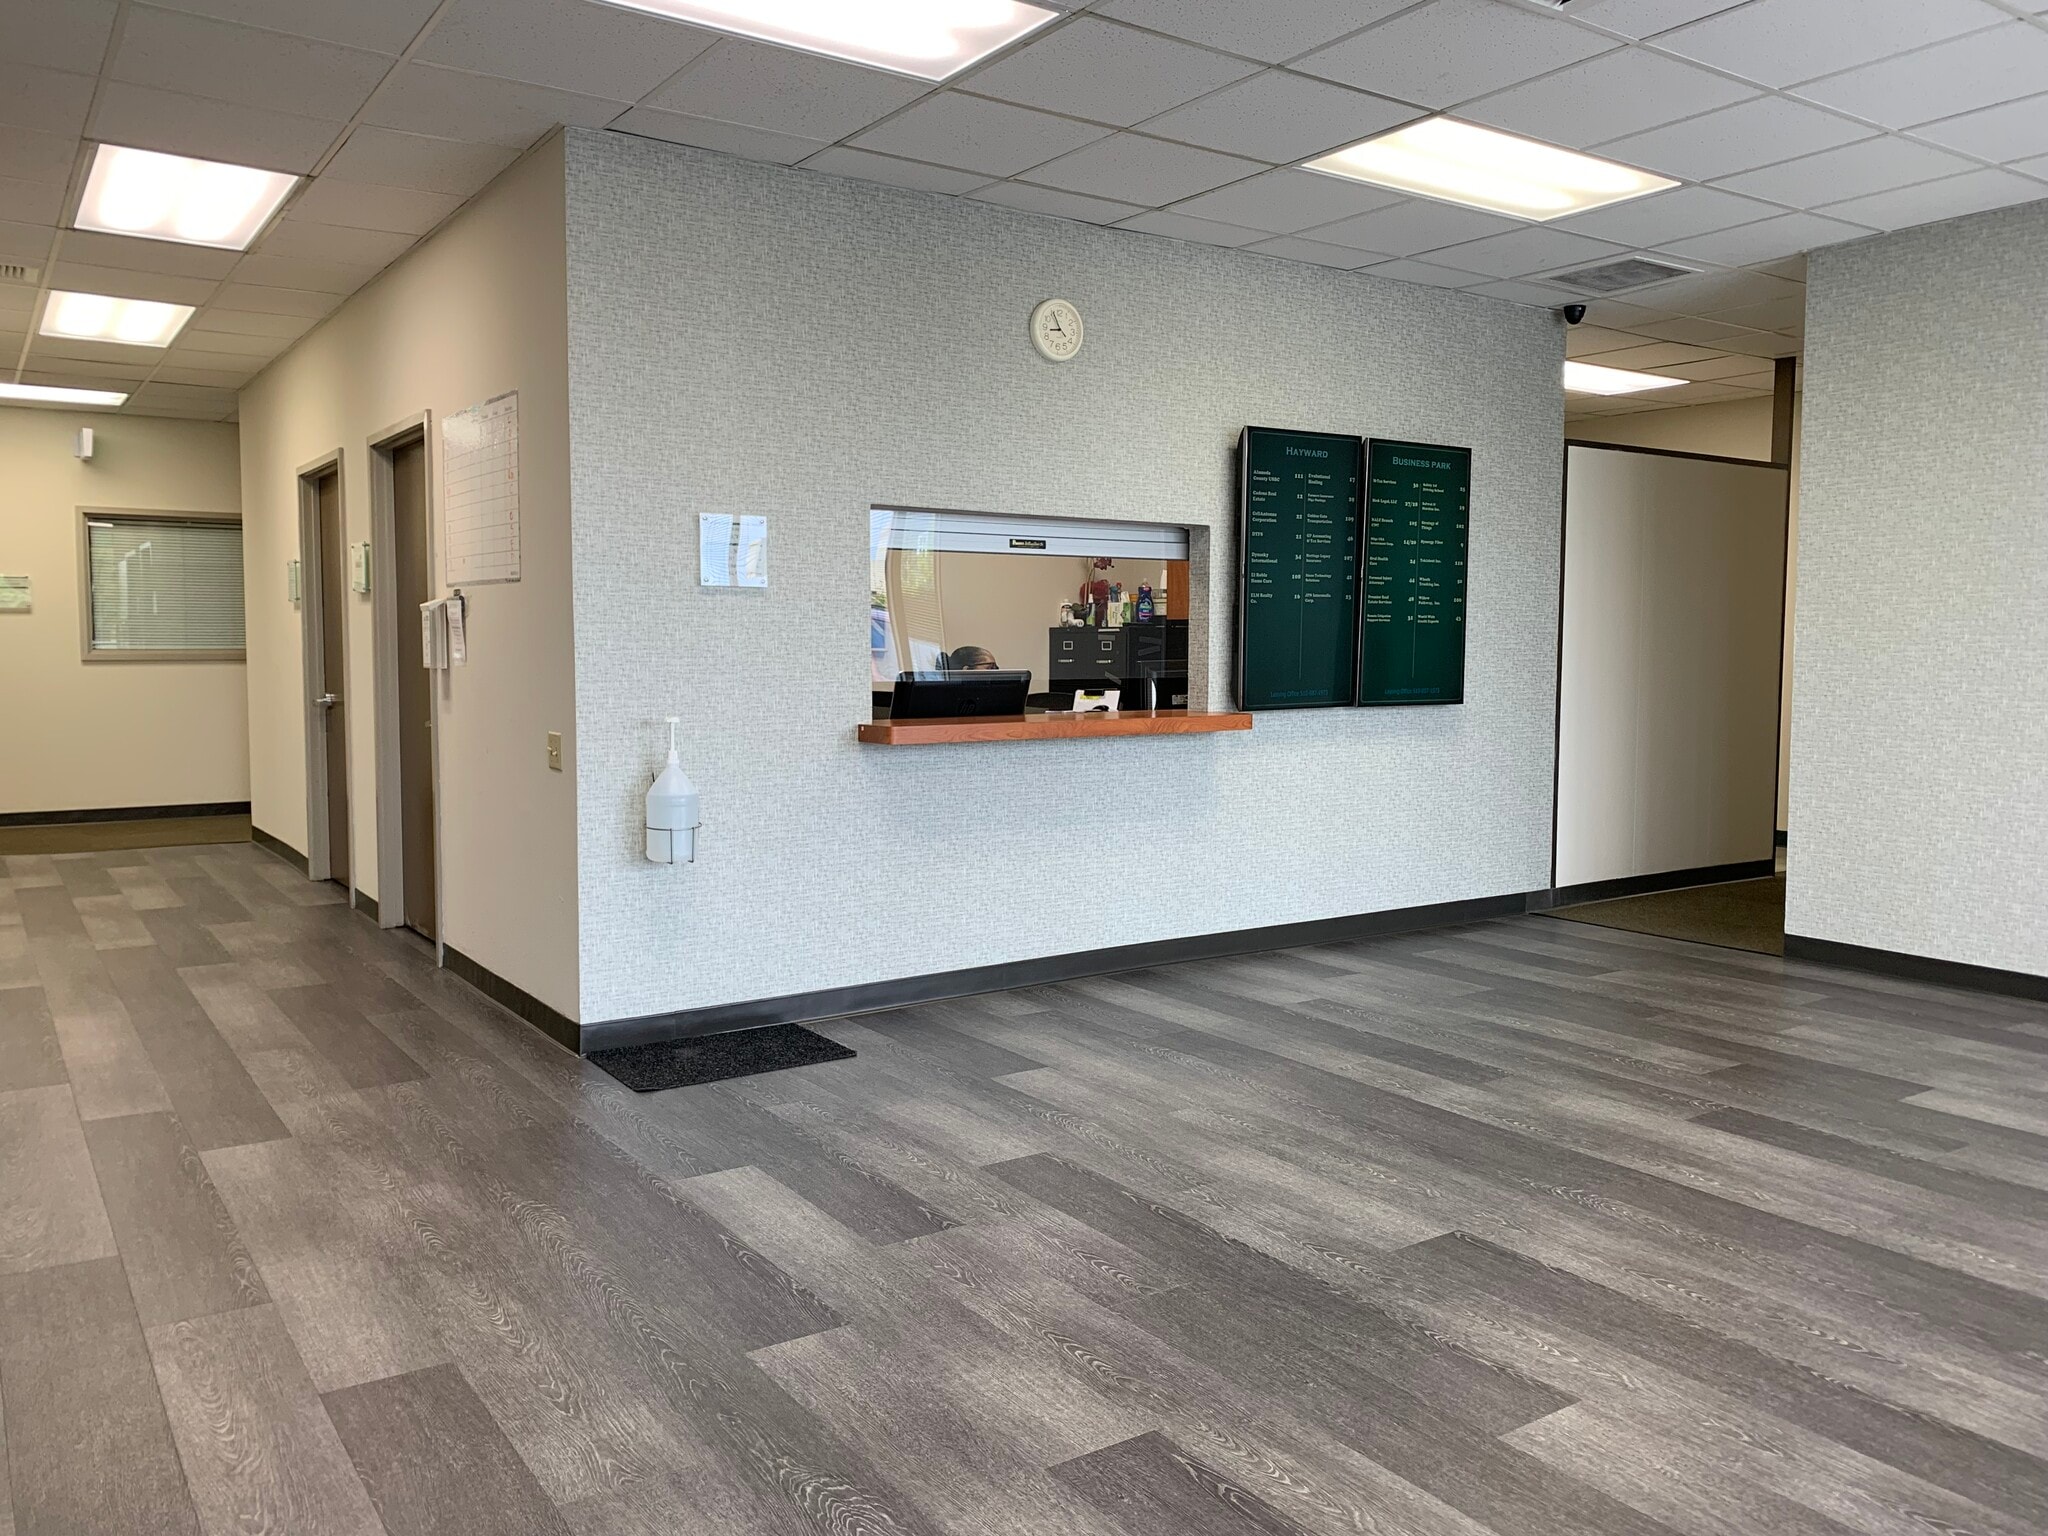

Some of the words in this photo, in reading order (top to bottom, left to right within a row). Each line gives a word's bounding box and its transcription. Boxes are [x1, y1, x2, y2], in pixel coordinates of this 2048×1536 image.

[1286, 446, 1328, 458] HAYWARD
[1392, 456, 1430, 468] BUSINESS
[1432, 461, 1452, 470] PARK
